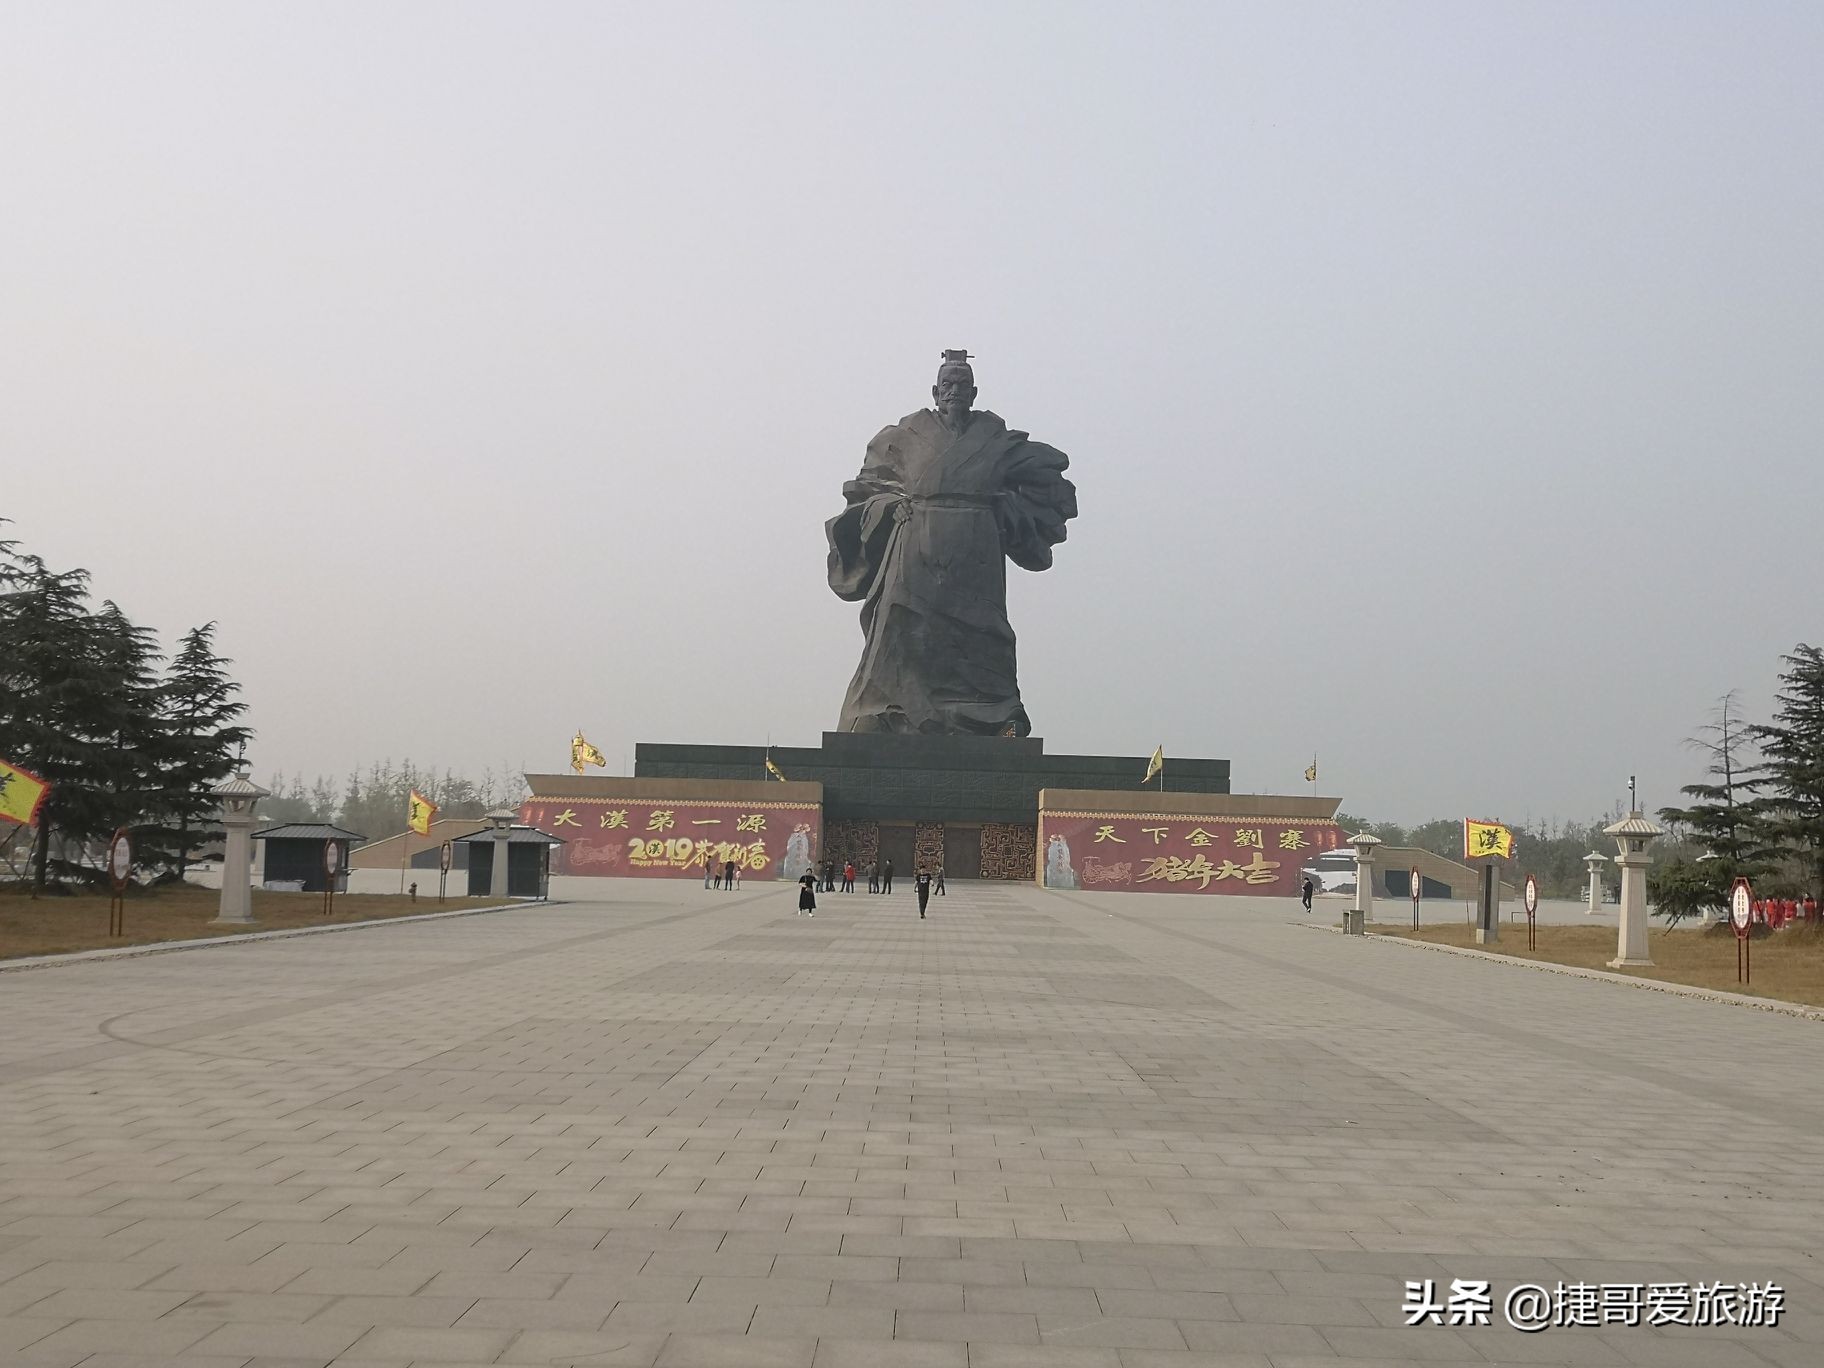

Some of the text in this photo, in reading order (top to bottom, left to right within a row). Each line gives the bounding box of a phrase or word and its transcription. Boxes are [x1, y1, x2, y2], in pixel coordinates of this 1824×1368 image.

[1094, 825, 1310, 849] 天下金劉寨
[1479, 828, 1502, 849] 漢
[630, 858, 652, 867] Happy
[669, 858, 687, 866] Year
